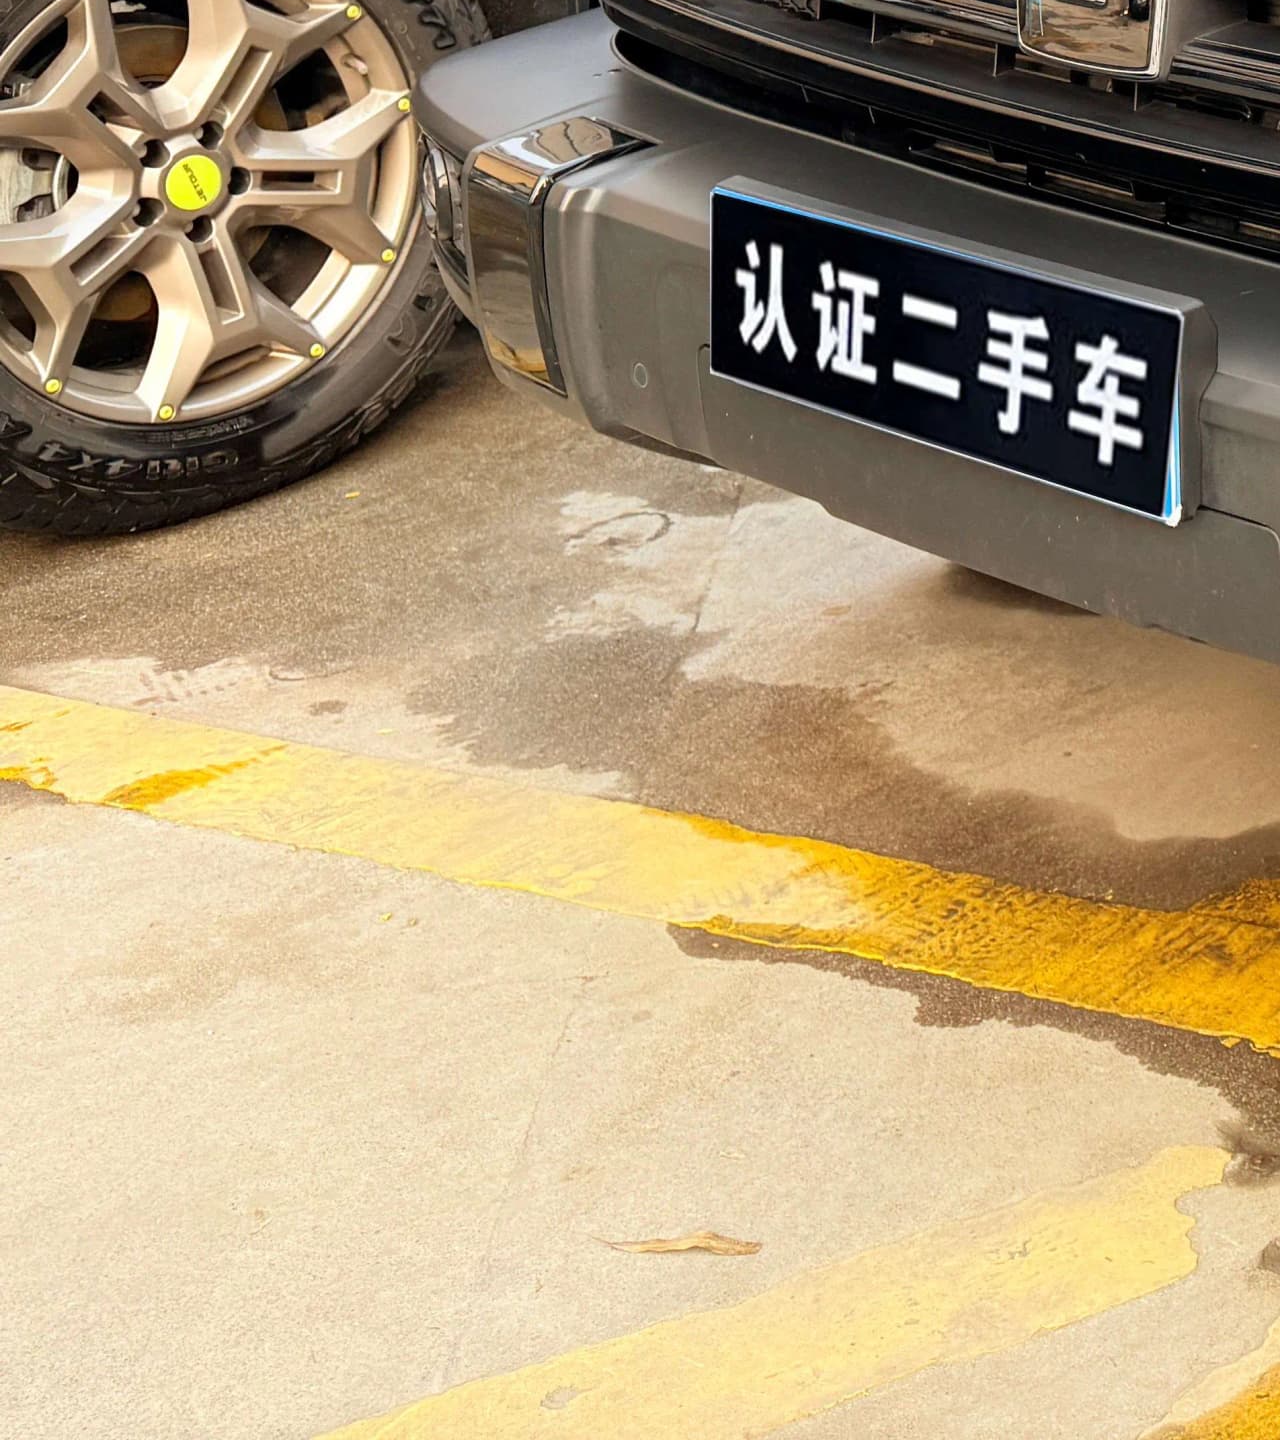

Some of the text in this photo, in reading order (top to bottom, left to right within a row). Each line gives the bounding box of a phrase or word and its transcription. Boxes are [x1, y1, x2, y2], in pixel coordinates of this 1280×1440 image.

[182, 163, 207, 202] JETOUR
[734, 240, 1148, 466] 认证二手车
